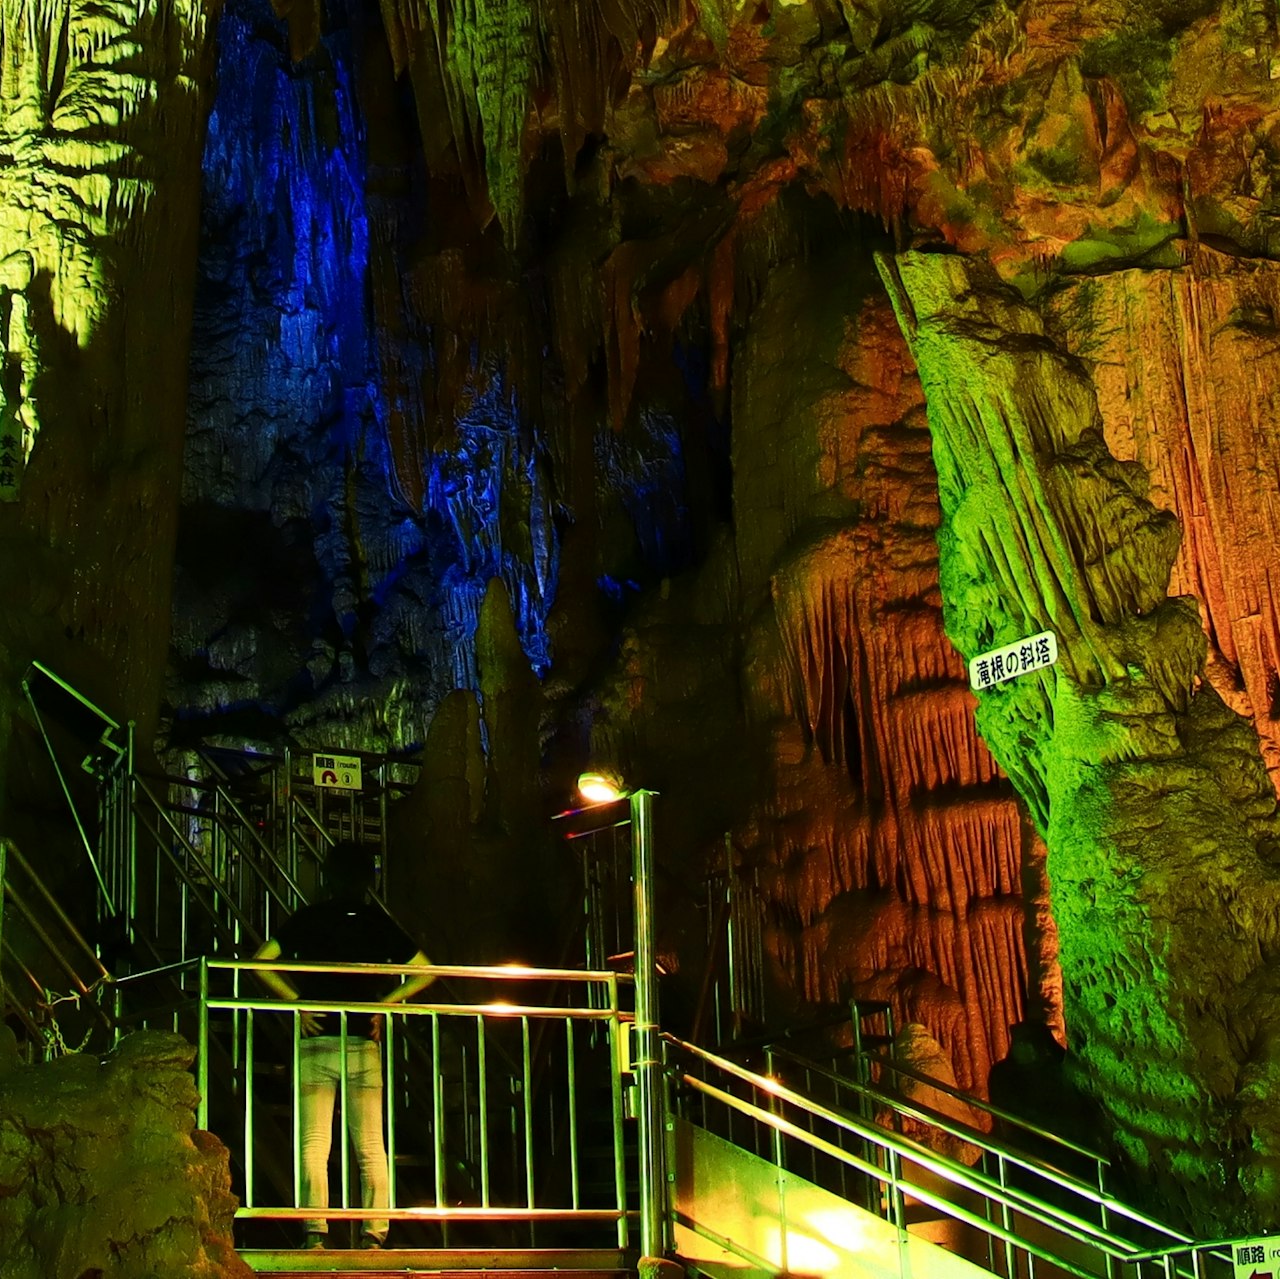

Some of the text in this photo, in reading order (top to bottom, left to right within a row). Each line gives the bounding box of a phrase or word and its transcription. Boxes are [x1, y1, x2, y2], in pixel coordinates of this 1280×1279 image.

[976, 637, 1050, 687] 滝根の斜塔
[1237, 1245, 1264, 1265] 順路
